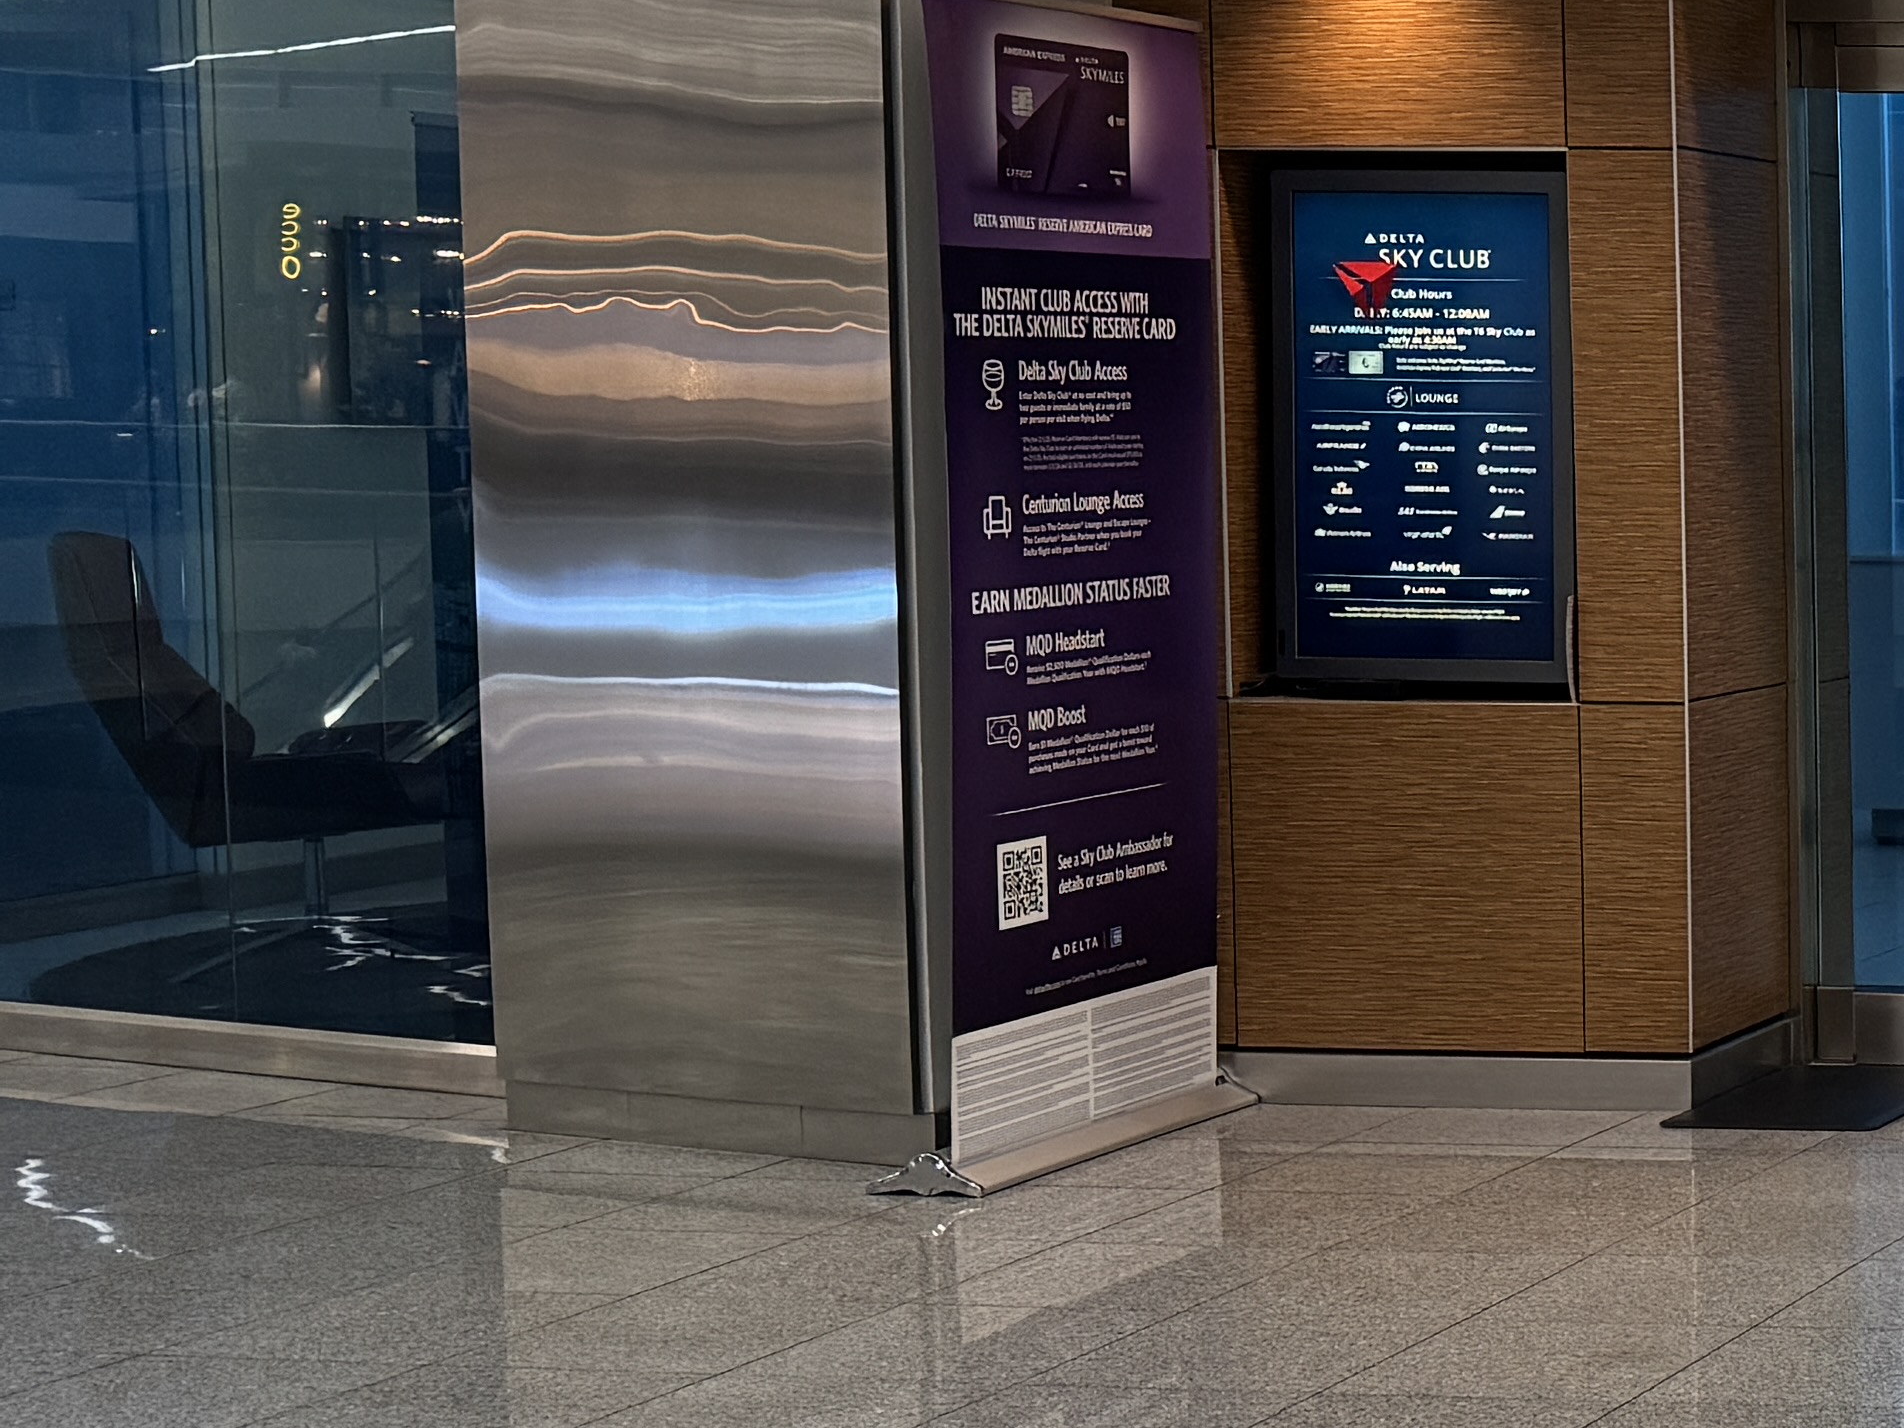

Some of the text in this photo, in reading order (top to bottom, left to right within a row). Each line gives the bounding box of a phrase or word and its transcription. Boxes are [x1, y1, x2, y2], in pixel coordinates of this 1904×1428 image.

[1080, 66, 1125, 84] SKYMILES
[1379, 233, 1425, 244] DELTA
[1378, 249, 1490, 269] SKY CLUB
[981, 286, 1149, 314] INSTANT CLUB ACCESS WITH
[1391, 288, 1453, 300] Club Hours
[953, 313, 979, 337] THE
[982, 314, 1024, 338] DELTA
[1093, 317, 1141, 339] RESERVE
[1142, 318, 1177, 340] CARD
[1018, 360, 1127, 385] Delta Sky Club Access
[1415, 393, 1459, 403] LOUNGE
[1022, 489, 1144, 515] Centurion Lounge Access
[1389, 561, 1461, 575] Also Serving
[971, 574, 1170, 615] EARN MEDALLION STATUS FASTER
[1026, 628, 1105, 657] MQD Headstart
[1028, 704, 1086, 731] MQD Boost
[1057, 831, 1173, 870] See a Sky Club Ambassador for
[1058, 859, 1168, 895] details or scan to learn more.
[1063, 936, 1099, 956] DELTA
